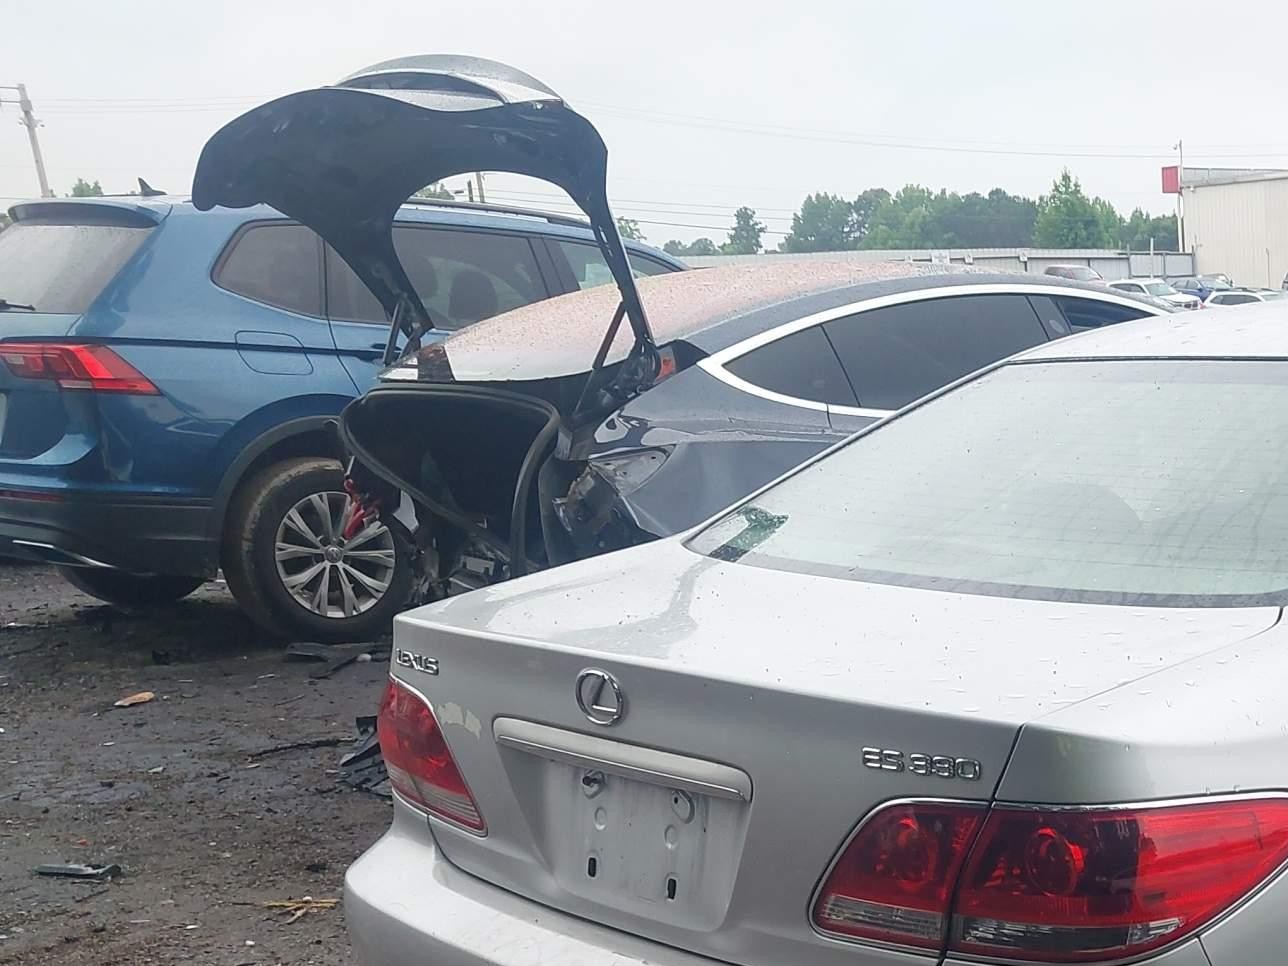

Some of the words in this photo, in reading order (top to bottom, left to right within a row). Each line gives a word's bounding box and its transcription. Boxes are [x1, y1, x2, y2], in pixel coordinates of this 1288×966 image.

[396, 648, 439, 676] LEXUS
[862, 746, 904, 772] ES
[909, 752, 980, 780] 330
